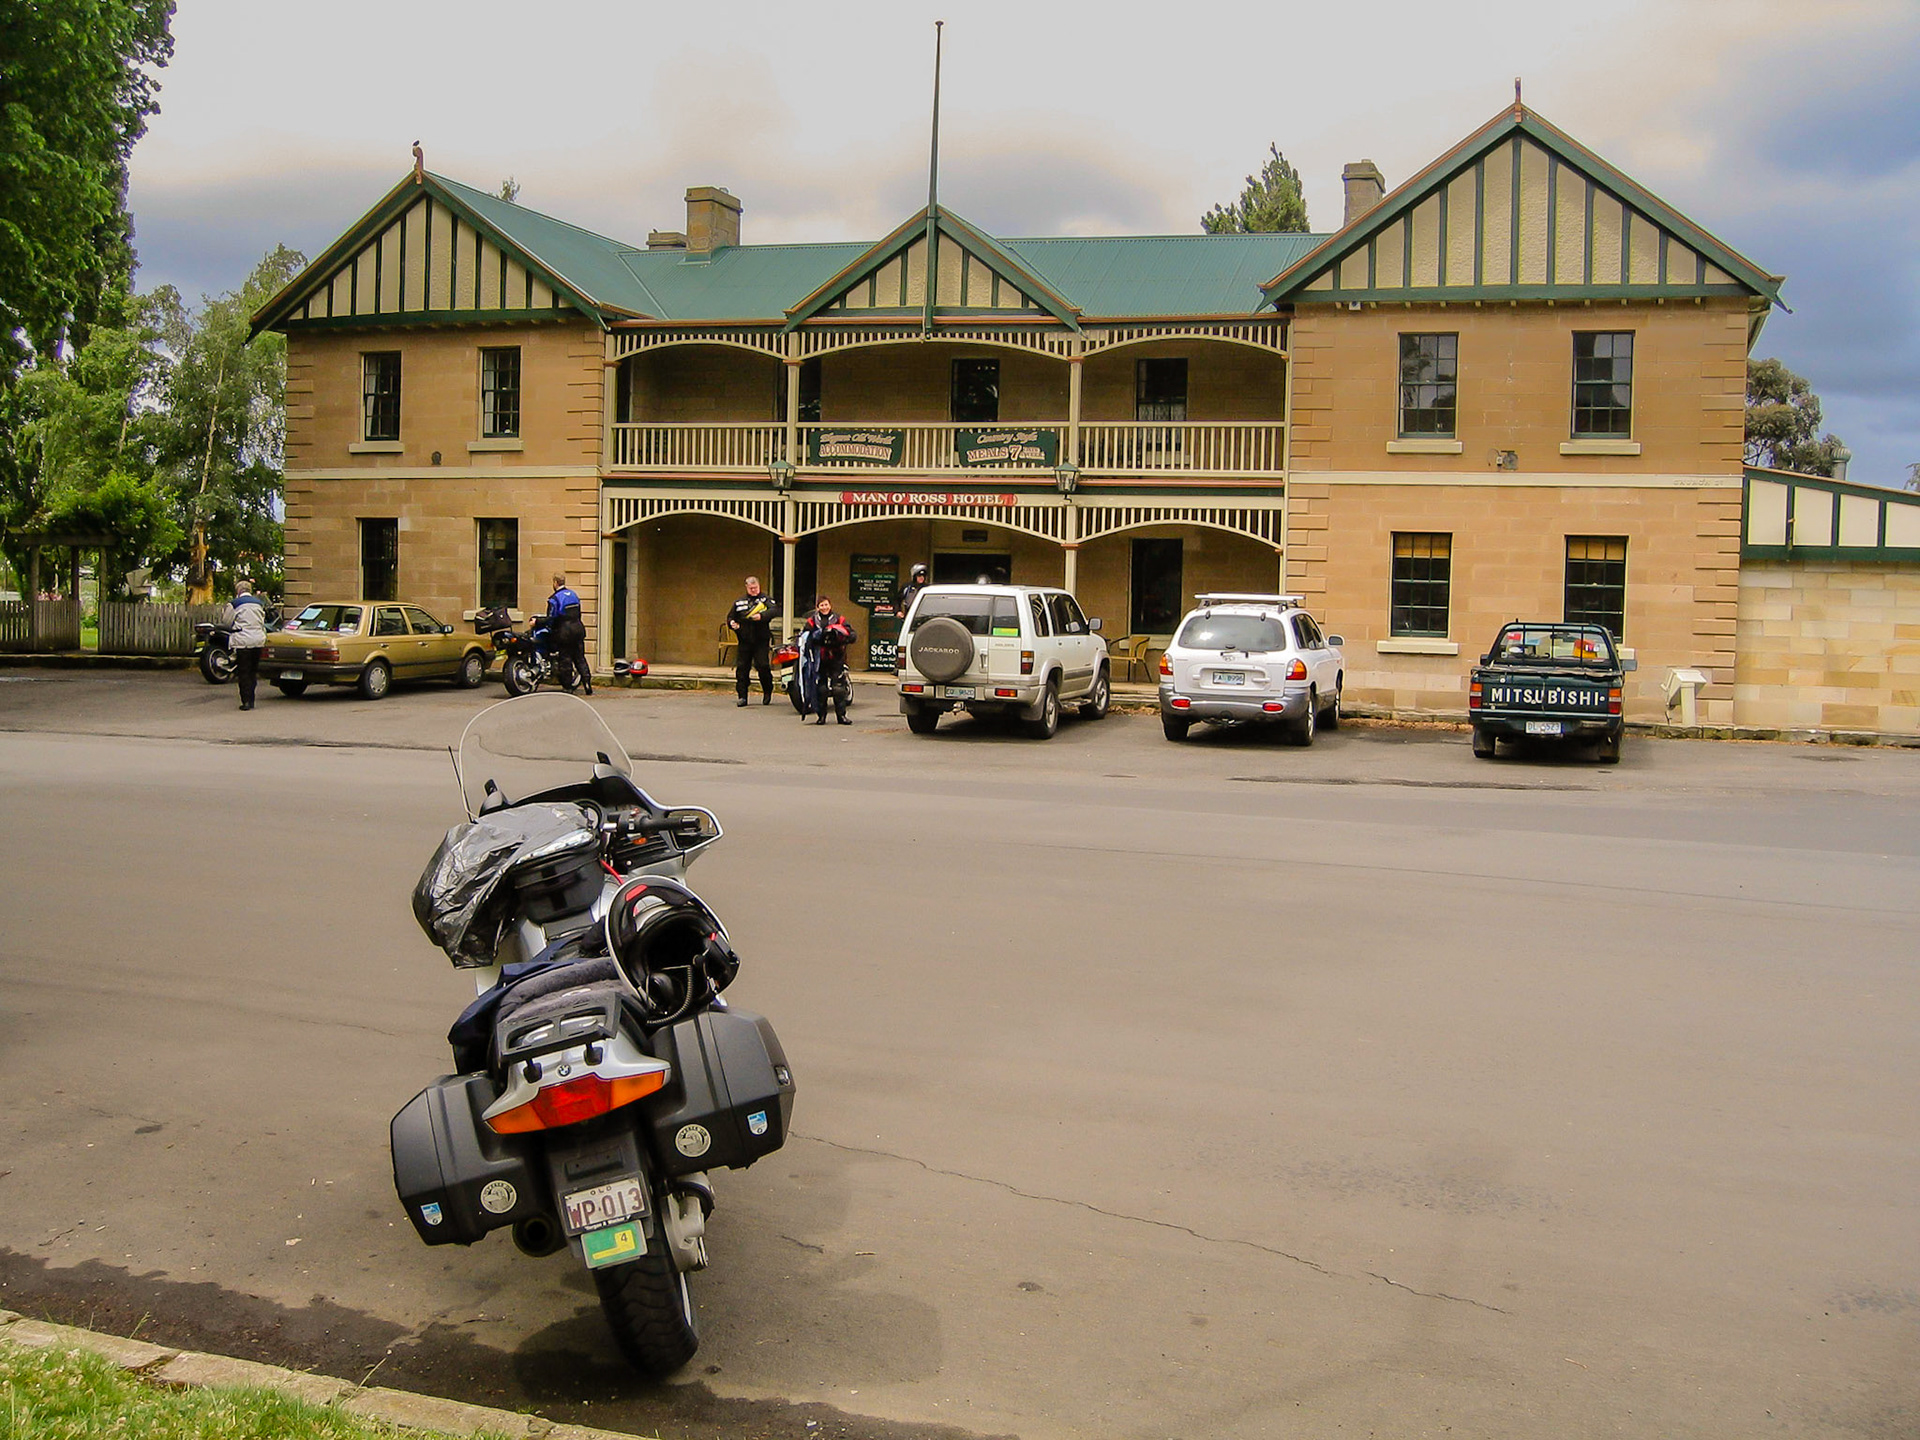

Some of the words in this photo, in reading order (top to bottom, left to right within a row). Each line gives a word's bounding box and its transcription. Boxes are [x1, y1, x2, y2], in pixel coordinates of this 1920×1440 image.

[851, 433, 870, 442] Old
[977, 434, 1014, 444] Country
[819, 443, 893, 461] ACCOMMODATION
[966, 446, 1009, 462] MEALS
[1008, 444, 1022, 461] 7
[852, 492, 889, 504] MAN
[891, 492, 906, 504] O'
[909, 493, 947, 505] ROSS
[952, 493, 1002, 506] HOTEL
[918, 646, 960, 655] JACKAROO
[1491, 687, 1600, 706] MITSUBISHI
